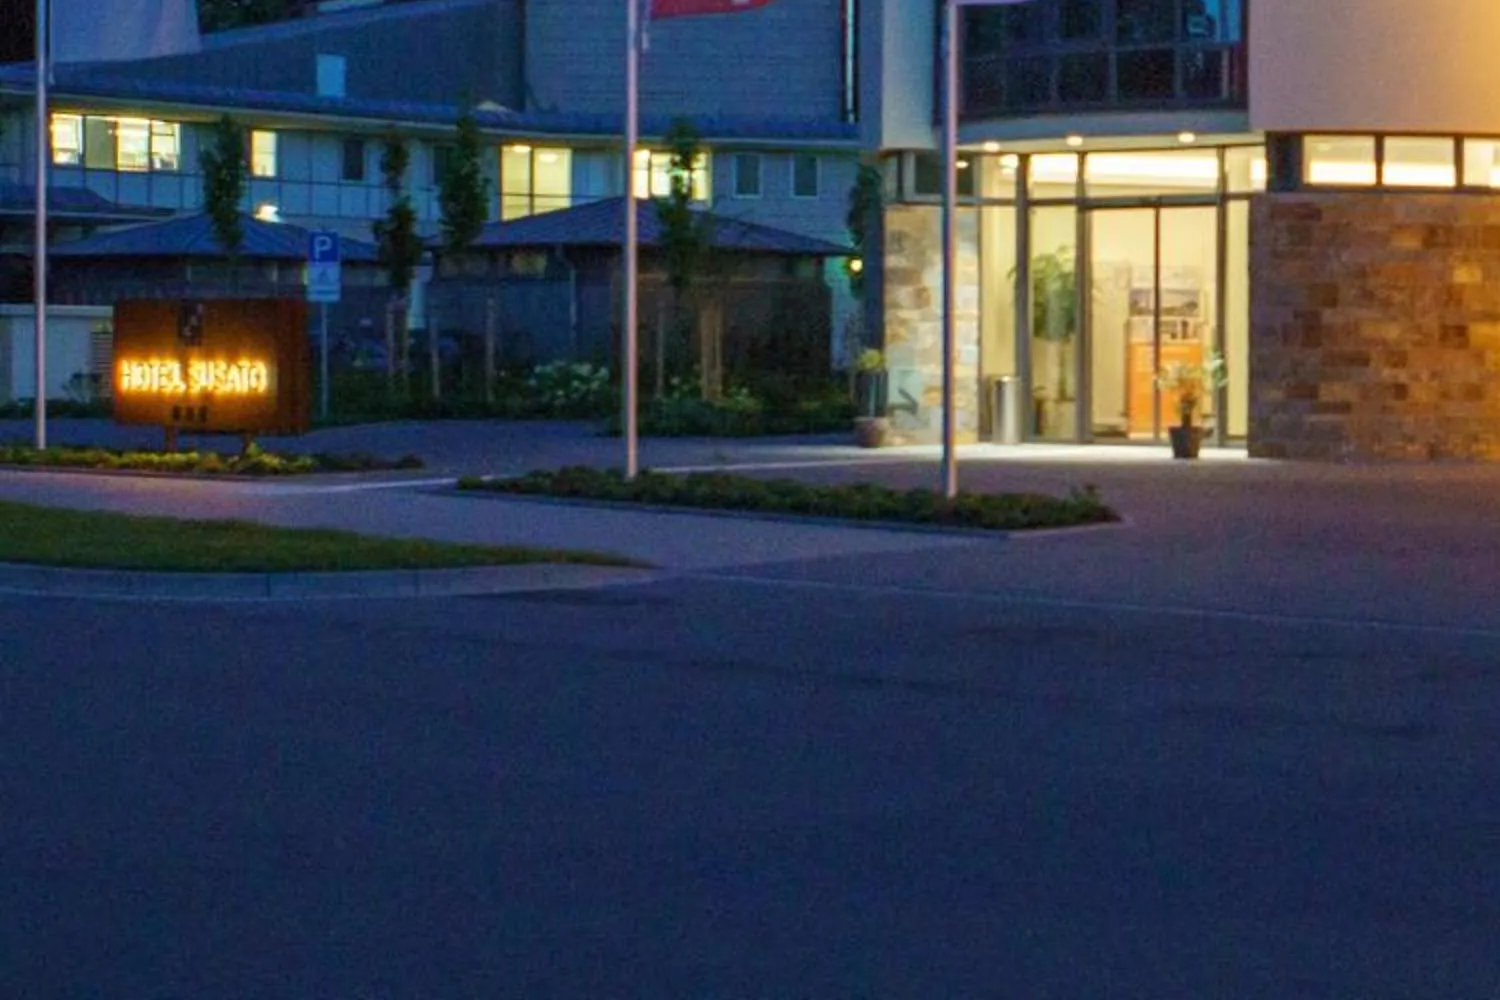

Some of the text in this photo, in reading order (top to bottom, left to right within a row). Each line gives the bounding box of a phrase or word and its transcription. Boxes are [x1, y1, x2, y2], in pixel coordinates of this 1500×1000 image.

[314, 235, 333, 261] P
[121, 359, 269, 394] HOTEL SUSATO
